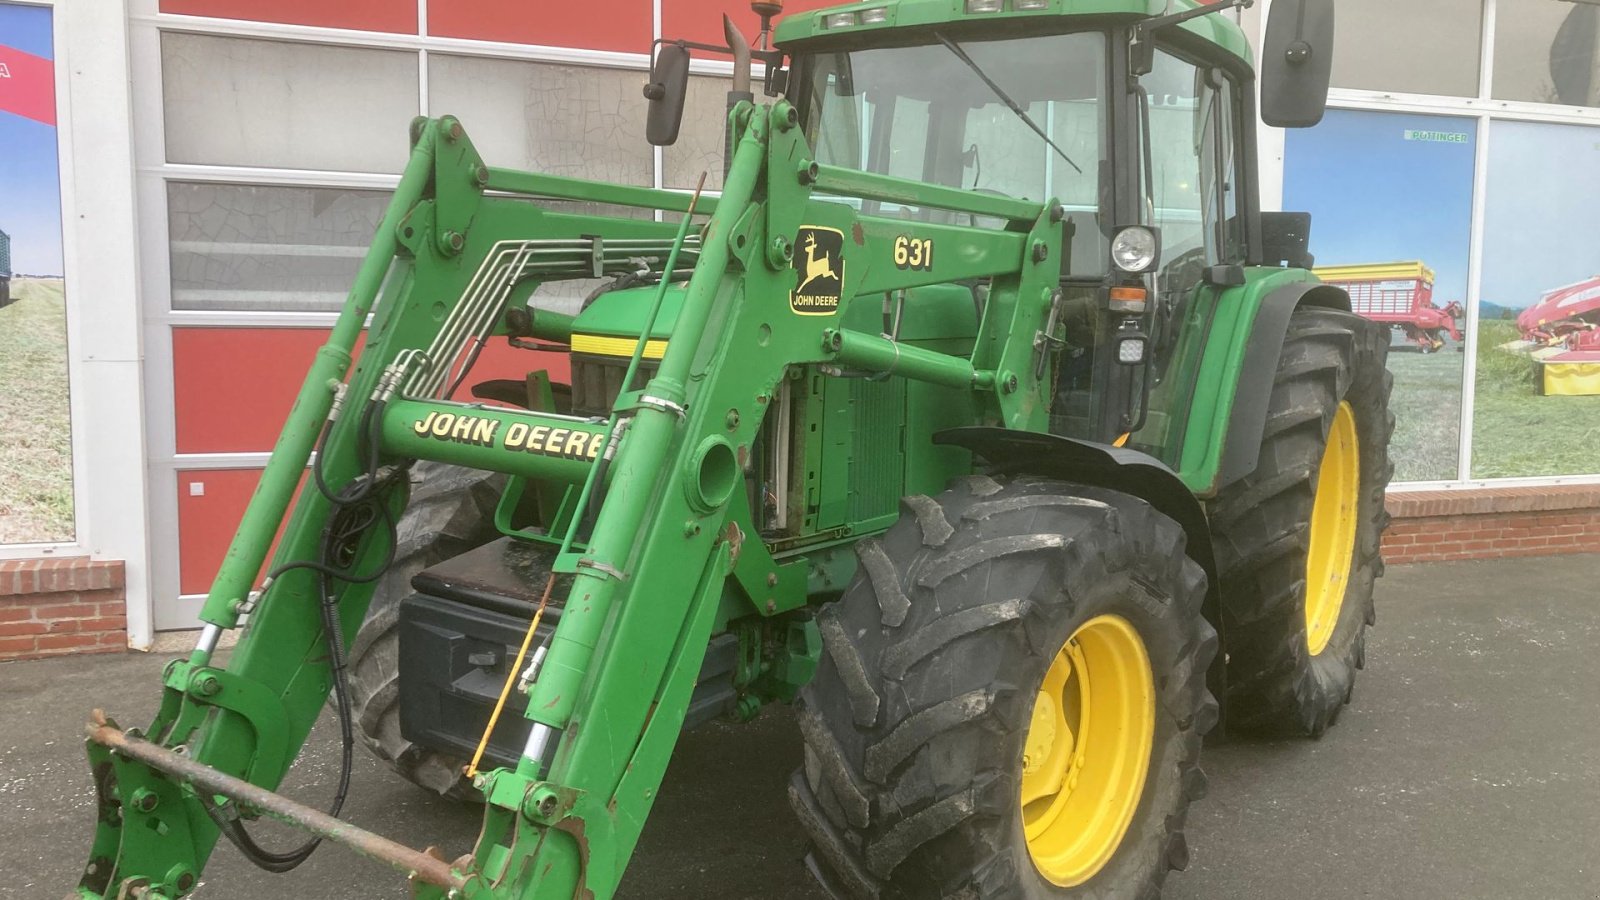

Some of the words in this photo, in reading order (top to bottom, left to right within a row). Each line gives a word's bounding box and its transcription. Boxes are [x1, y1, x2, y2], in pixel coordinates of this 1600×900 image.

[894, 236, 932, 269] 631
[793, 295, 814, 306] JOHN
[815, 296, 838, 306] DEERE
[414, 411, 500, 446] JOHN
